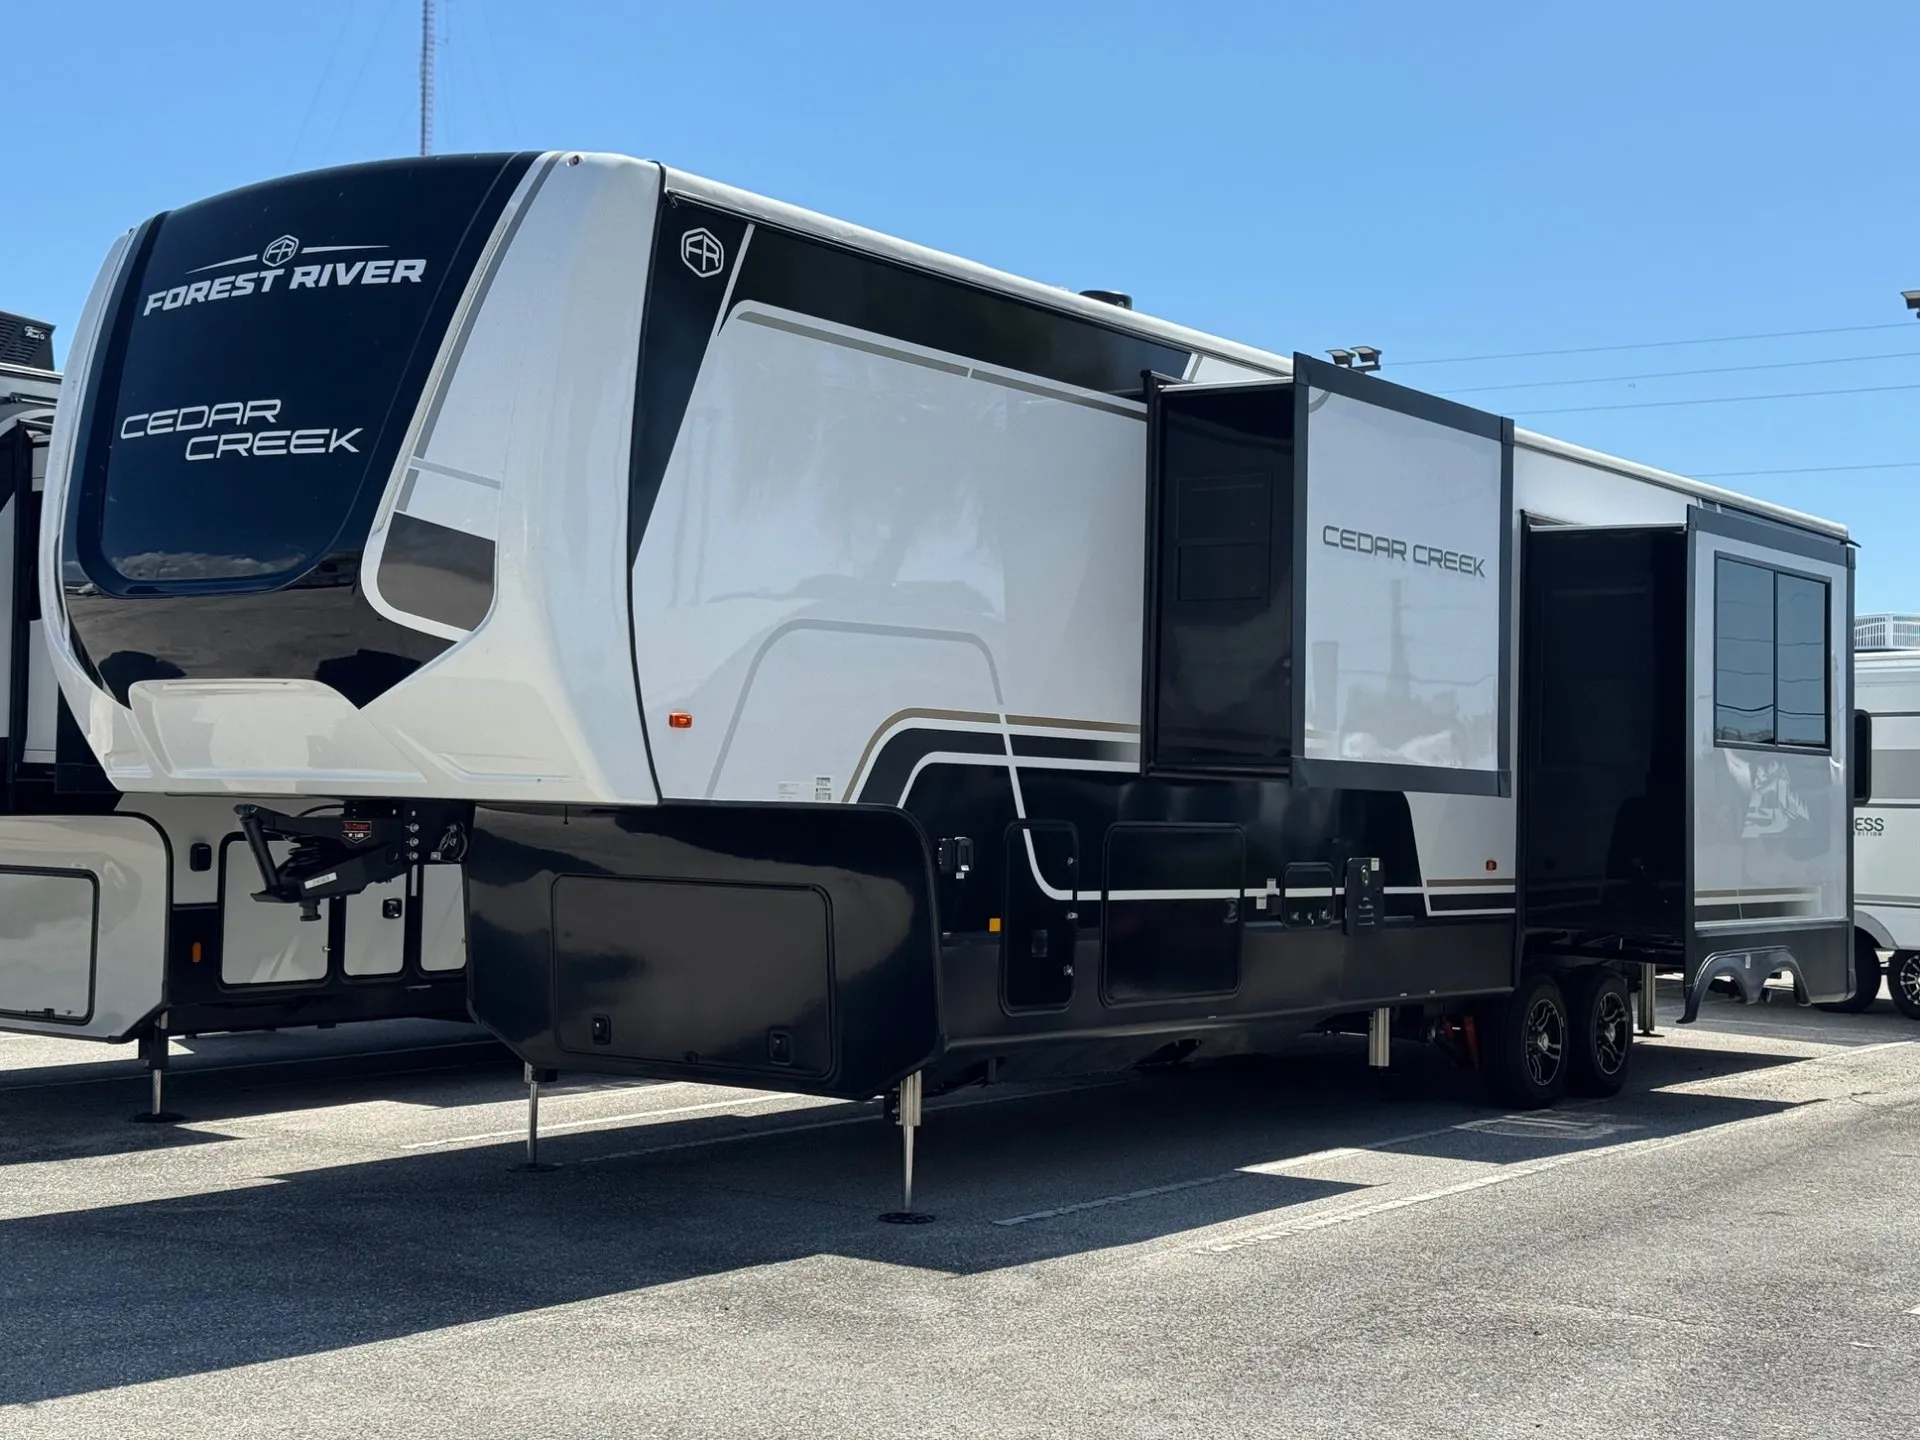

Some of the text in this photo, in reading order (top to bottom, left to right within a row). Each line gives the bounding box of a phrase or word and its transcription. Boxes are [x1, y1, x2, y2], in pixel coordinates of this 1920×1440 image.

[142, 259, 427, 317] FOREST RIVER
[120, 399, 282, 439] CEDAR
[185, 428, 363, 461] CREEK
[1322, 525, 1486, 578] CEDAR CREEK
